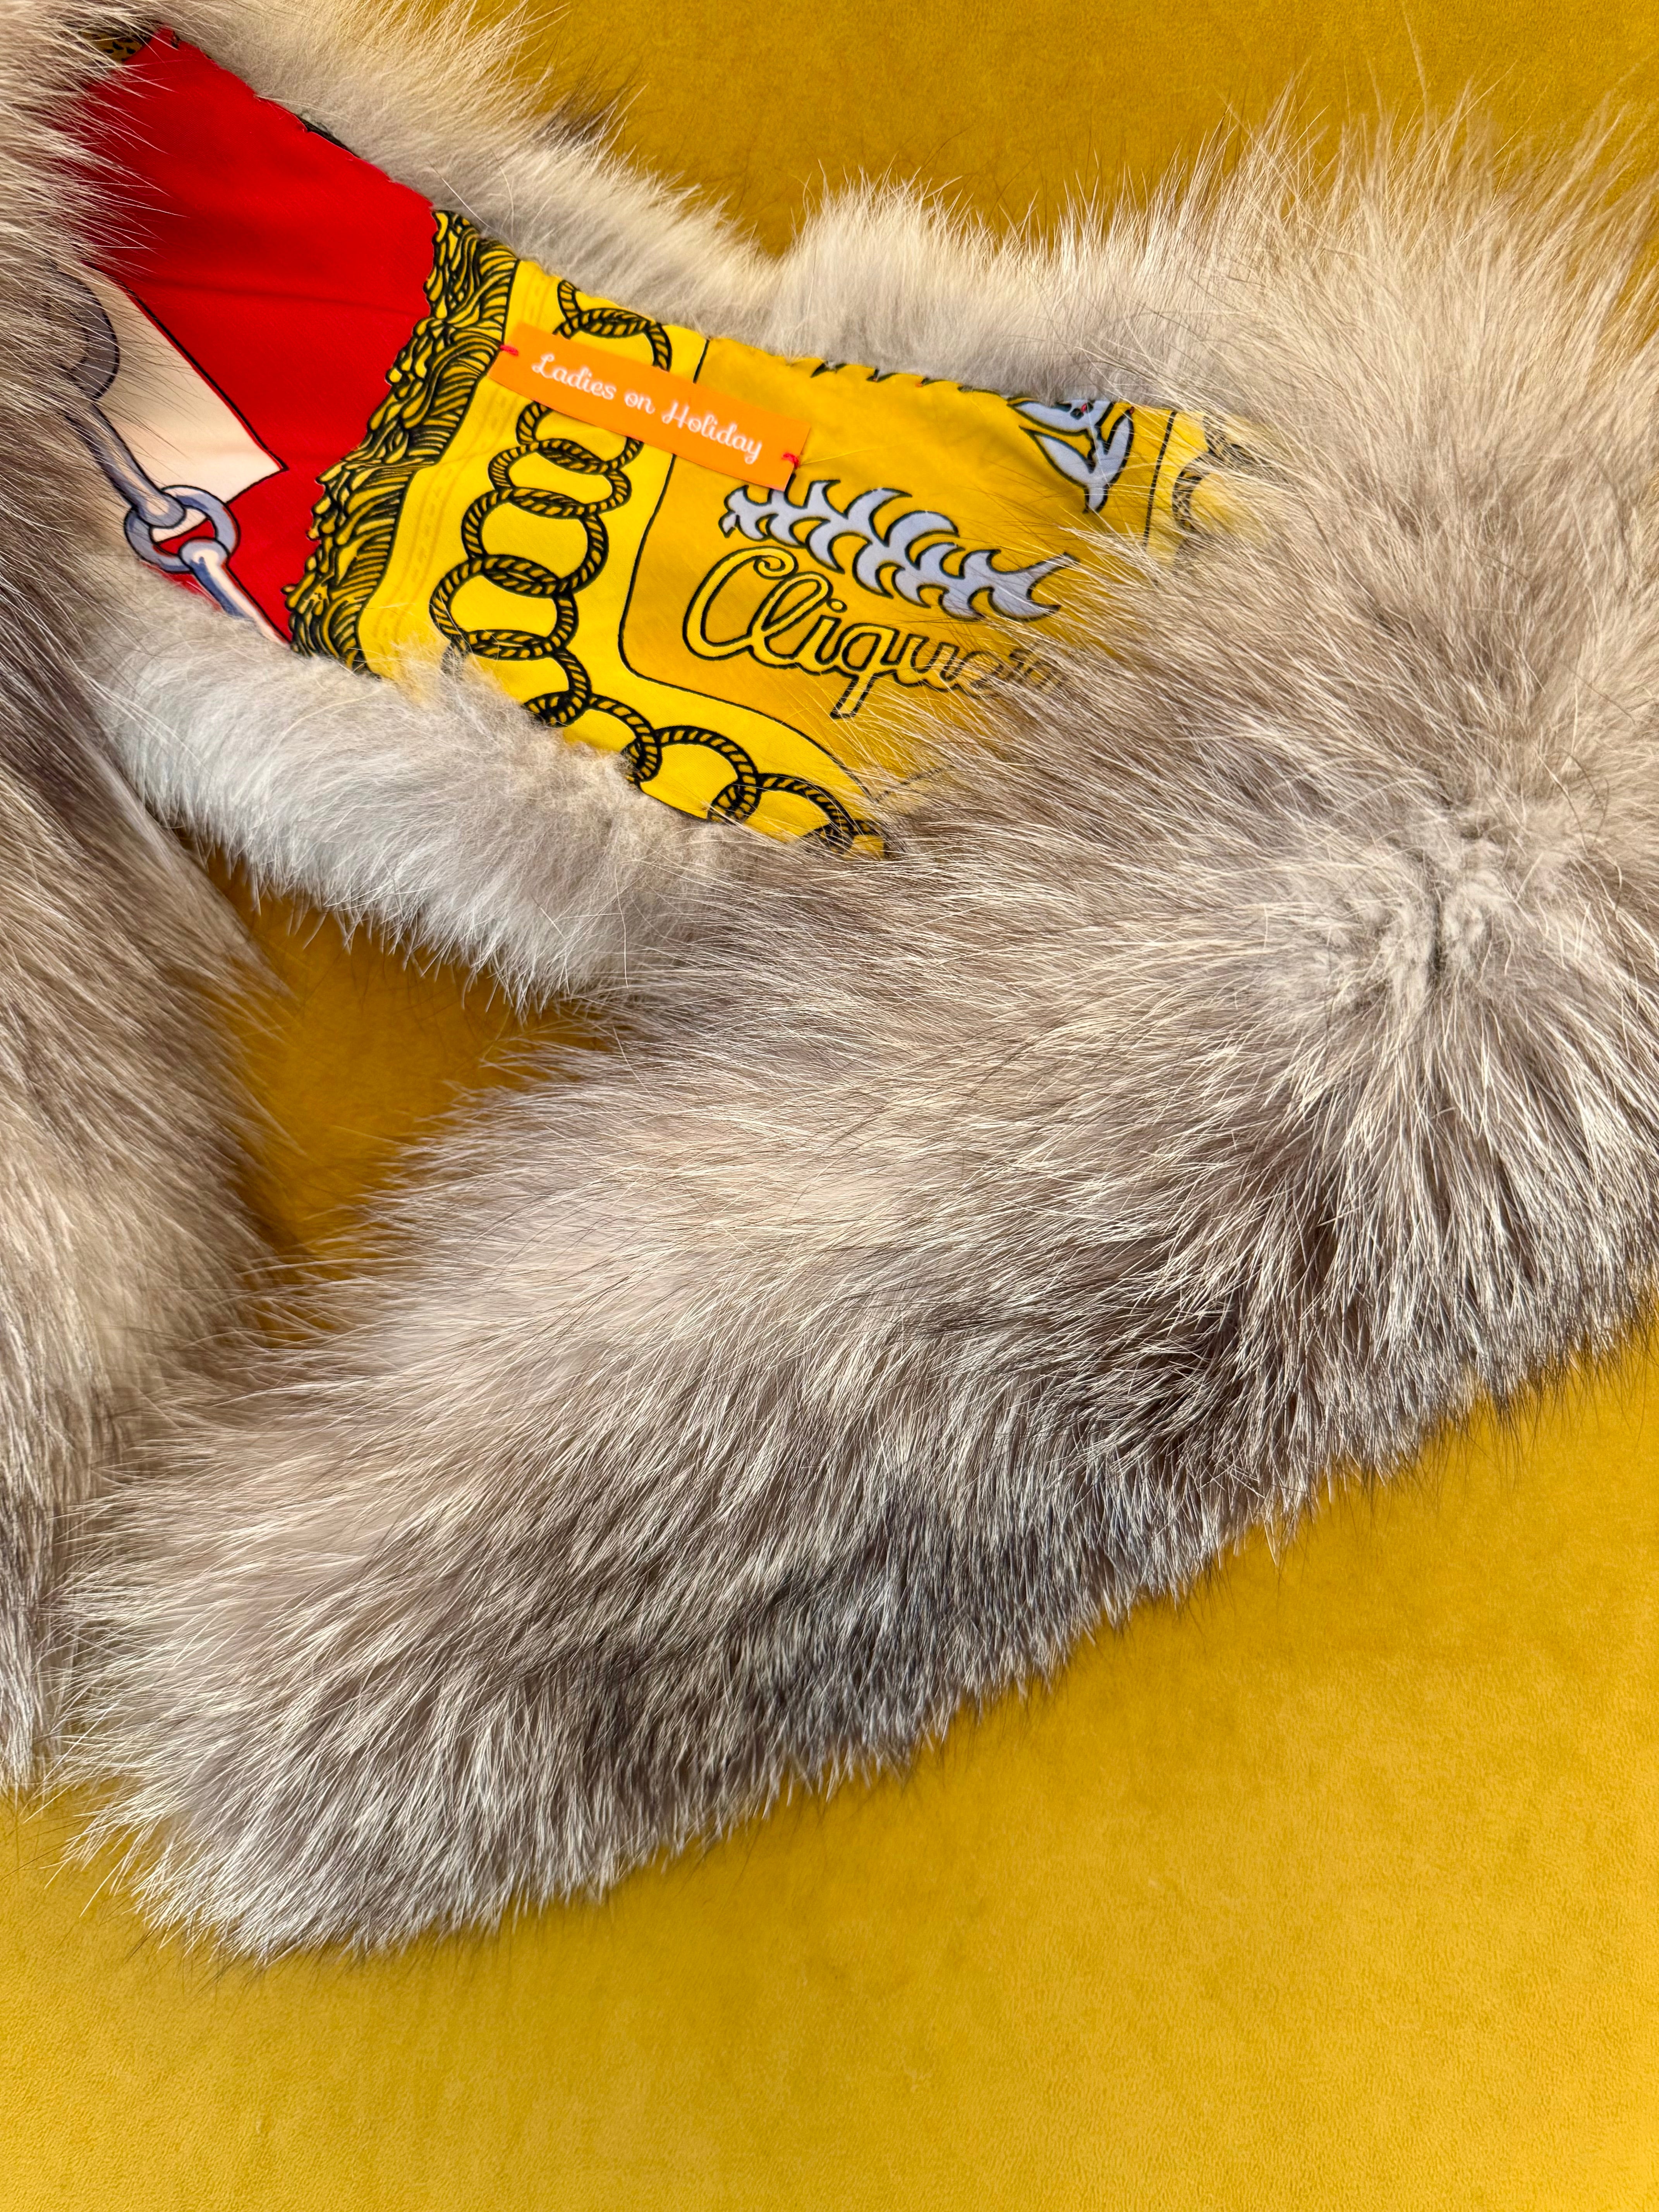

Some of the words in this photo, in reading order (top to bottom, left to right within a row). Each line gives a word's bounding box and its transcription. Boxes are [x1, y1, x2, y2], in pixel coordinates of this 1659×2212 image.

[532, 353, 617, 400] Ladies
[624, 392, 655, 414] on
[661, 401, 763, 465] Holiday
